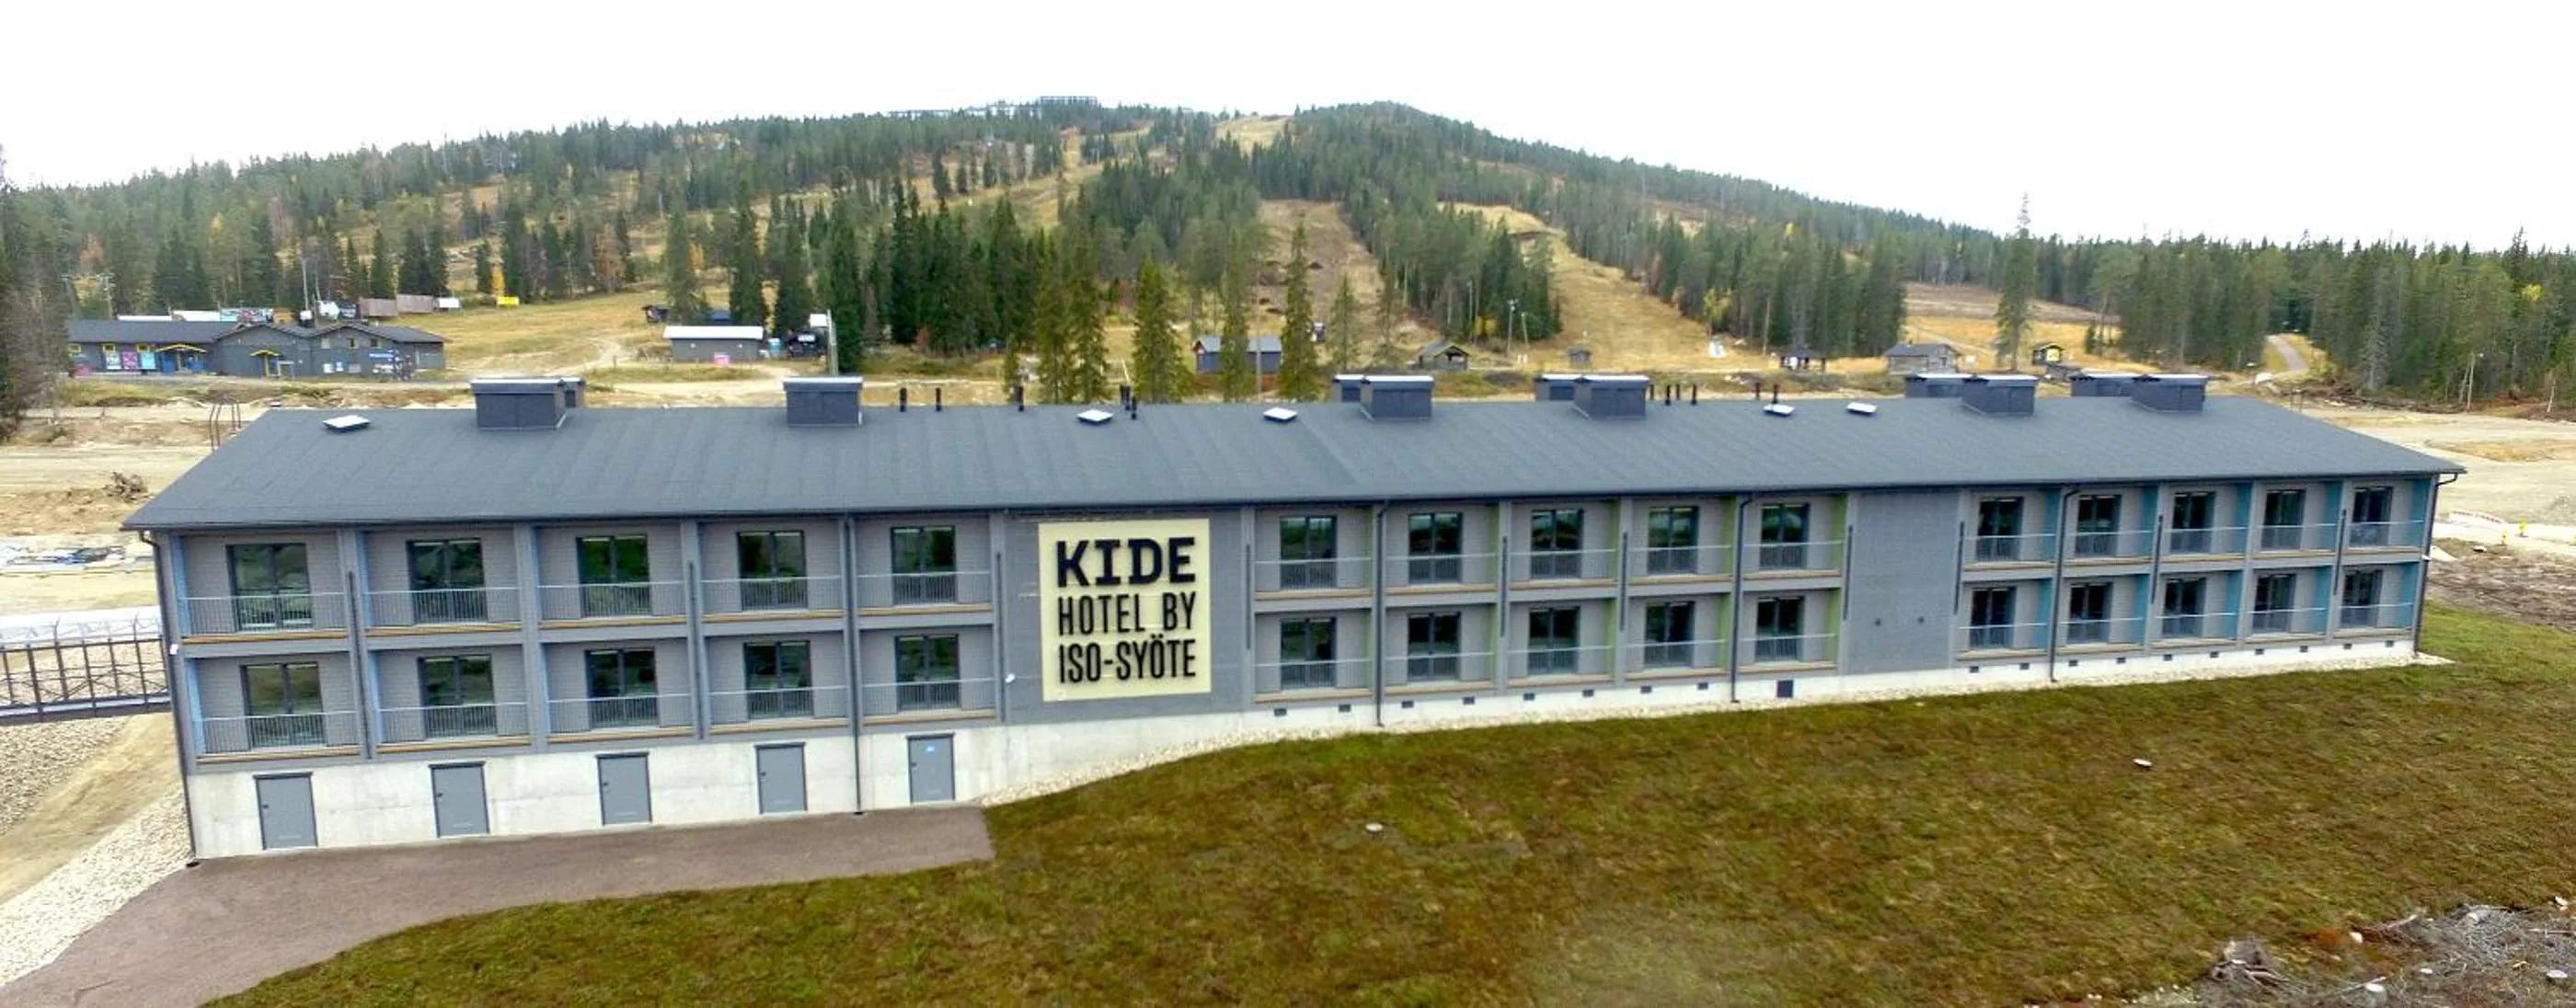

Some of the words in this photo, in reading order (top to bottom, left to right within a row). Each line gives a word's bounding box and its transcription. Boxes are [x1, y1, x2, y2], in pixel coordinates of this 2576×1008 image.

[1056, 537, 1196, 588] KIDE
[1058, 594, 1145, 636] HOTEL
[1162, 591, 1196, 631] BY
[1059, 633, 1196, 683] ISO-SYÖTE
